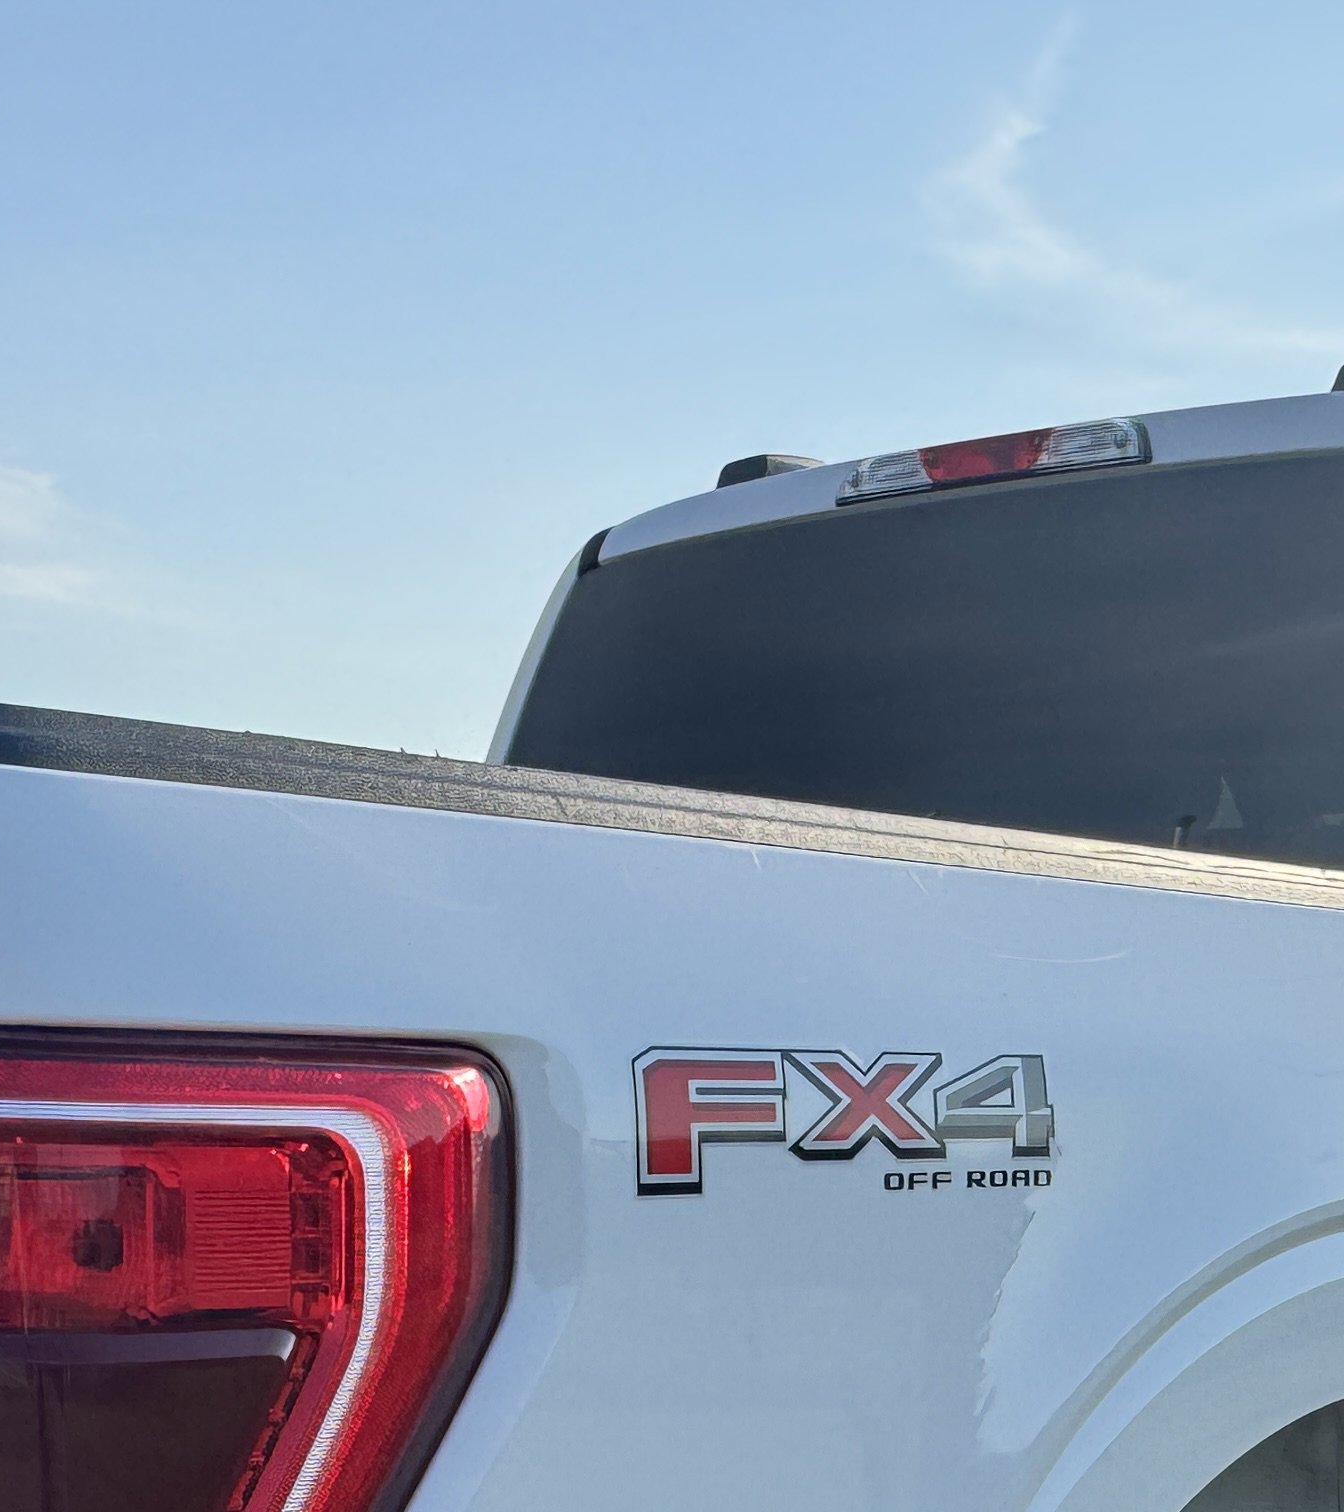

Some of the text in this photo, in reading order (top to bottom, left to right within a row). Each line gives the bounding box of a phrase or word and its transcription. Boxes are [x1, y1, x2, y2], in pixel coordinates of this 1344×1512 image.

[631, 1045, 1054, 1195] FX4
[883, 1169, 1052, 1191] OFF ROAD
